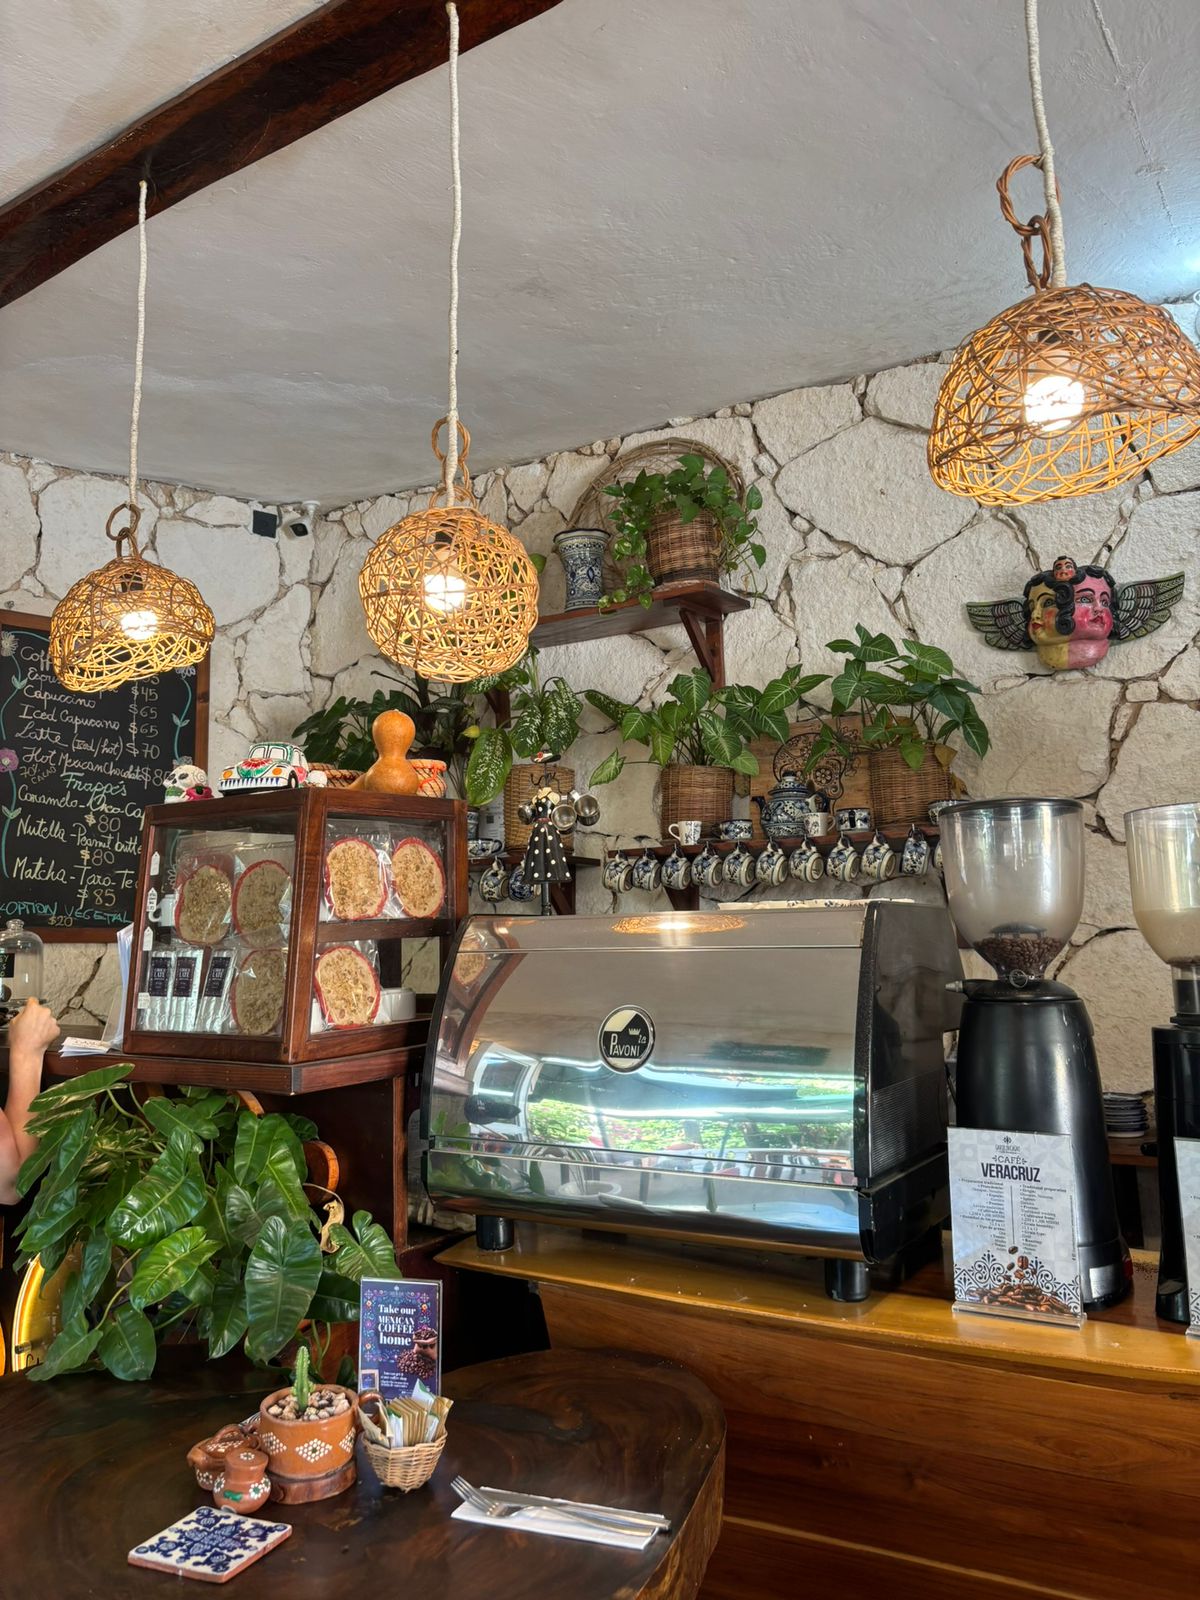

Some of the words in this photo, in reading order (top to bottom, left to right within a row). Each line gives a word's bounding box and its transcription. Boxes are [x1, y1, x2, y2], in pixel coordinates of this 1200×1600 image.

[20, 646, 52, 672] Coff
[131, 684, 159, 702] $45
[18, 703, 57, 722] Iced
[128, 722, 159, 739] $65
[128, 702, 158, 720] $65
[15, 720, 69, 747] Latte
[126, 738, 161, 759] $70
[22, 746, 57, 766] Hot
[16, 814, 68, 842] Nutella
[84, 812, 121, 833] $80
[80, 846, 115, 866] $80
[13, 856, 68, 884] Matcha
[76, 885, 116, 910] $85
[48, 915, 73, 927] $20
[997, 1154, 1022, 1165] CAFÉ
[980, 1162, 1041, 1183] VERACRUZ
[378, 1304, 399, 1314] Take
[400, 1306, 417, 1315] our
[378, 1323, 415, 1335] COFFEE
[379, 1332, 412, 1346] home
